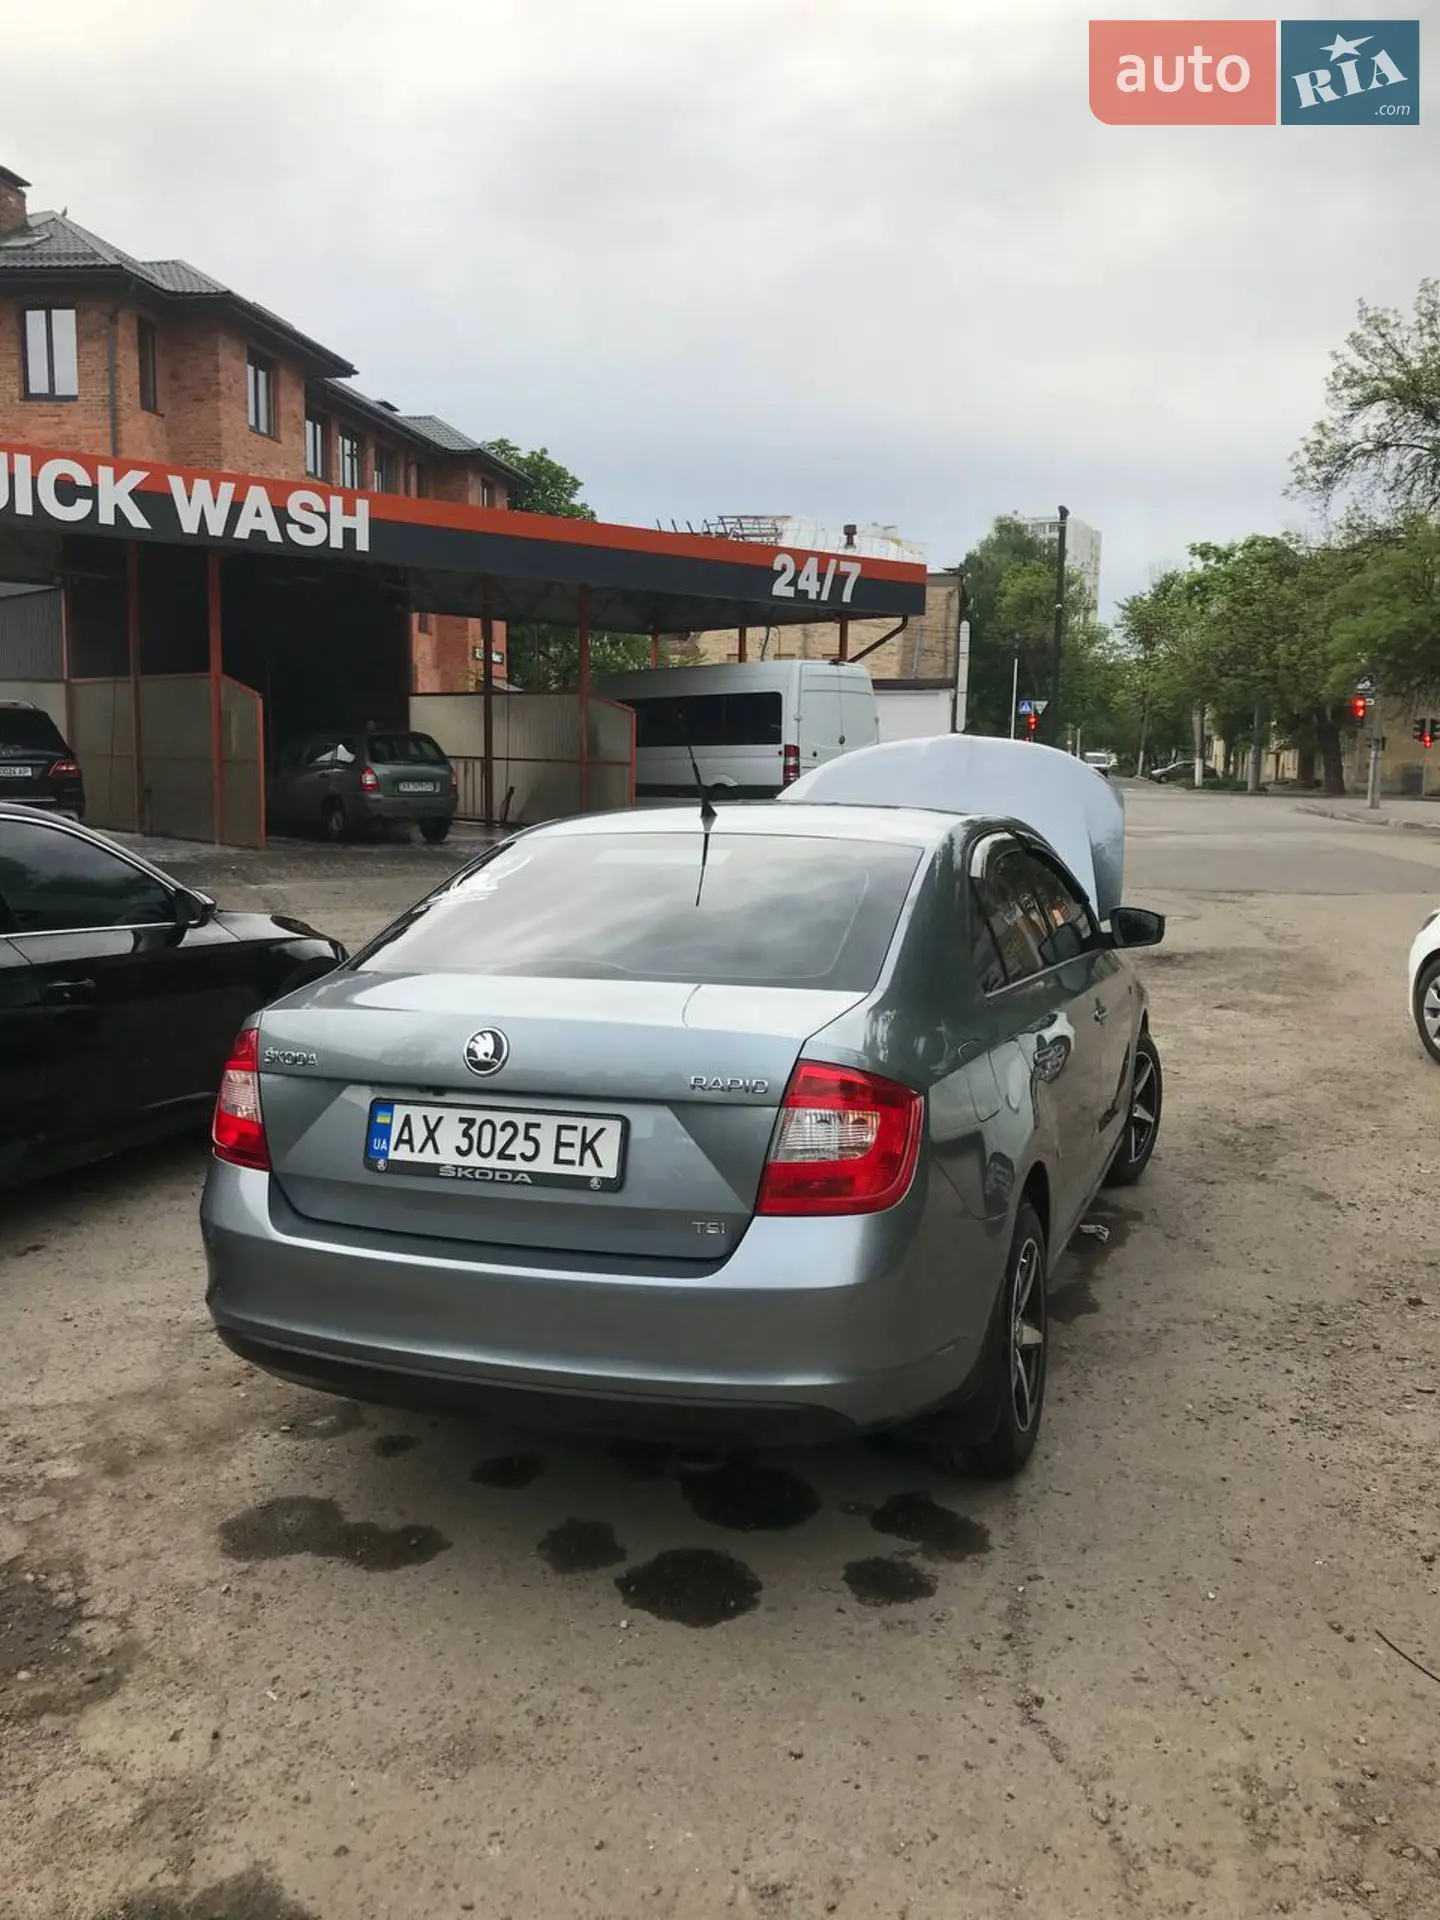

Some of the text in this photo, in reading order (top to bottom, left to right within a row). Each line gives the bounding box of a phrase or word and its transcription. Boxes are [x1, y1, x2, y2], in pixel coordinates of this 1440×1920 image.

[0, 449, 370, 552] ICK WASH
[772, 553, 862, 603] 24/7
[690, 1075, 769, 1094] RAPID
[373, 1139, 388, 1151] UA
[393, 1113, 607, 1169] AX 3025 EK
[691, 1221, 726, 1234] TSI
